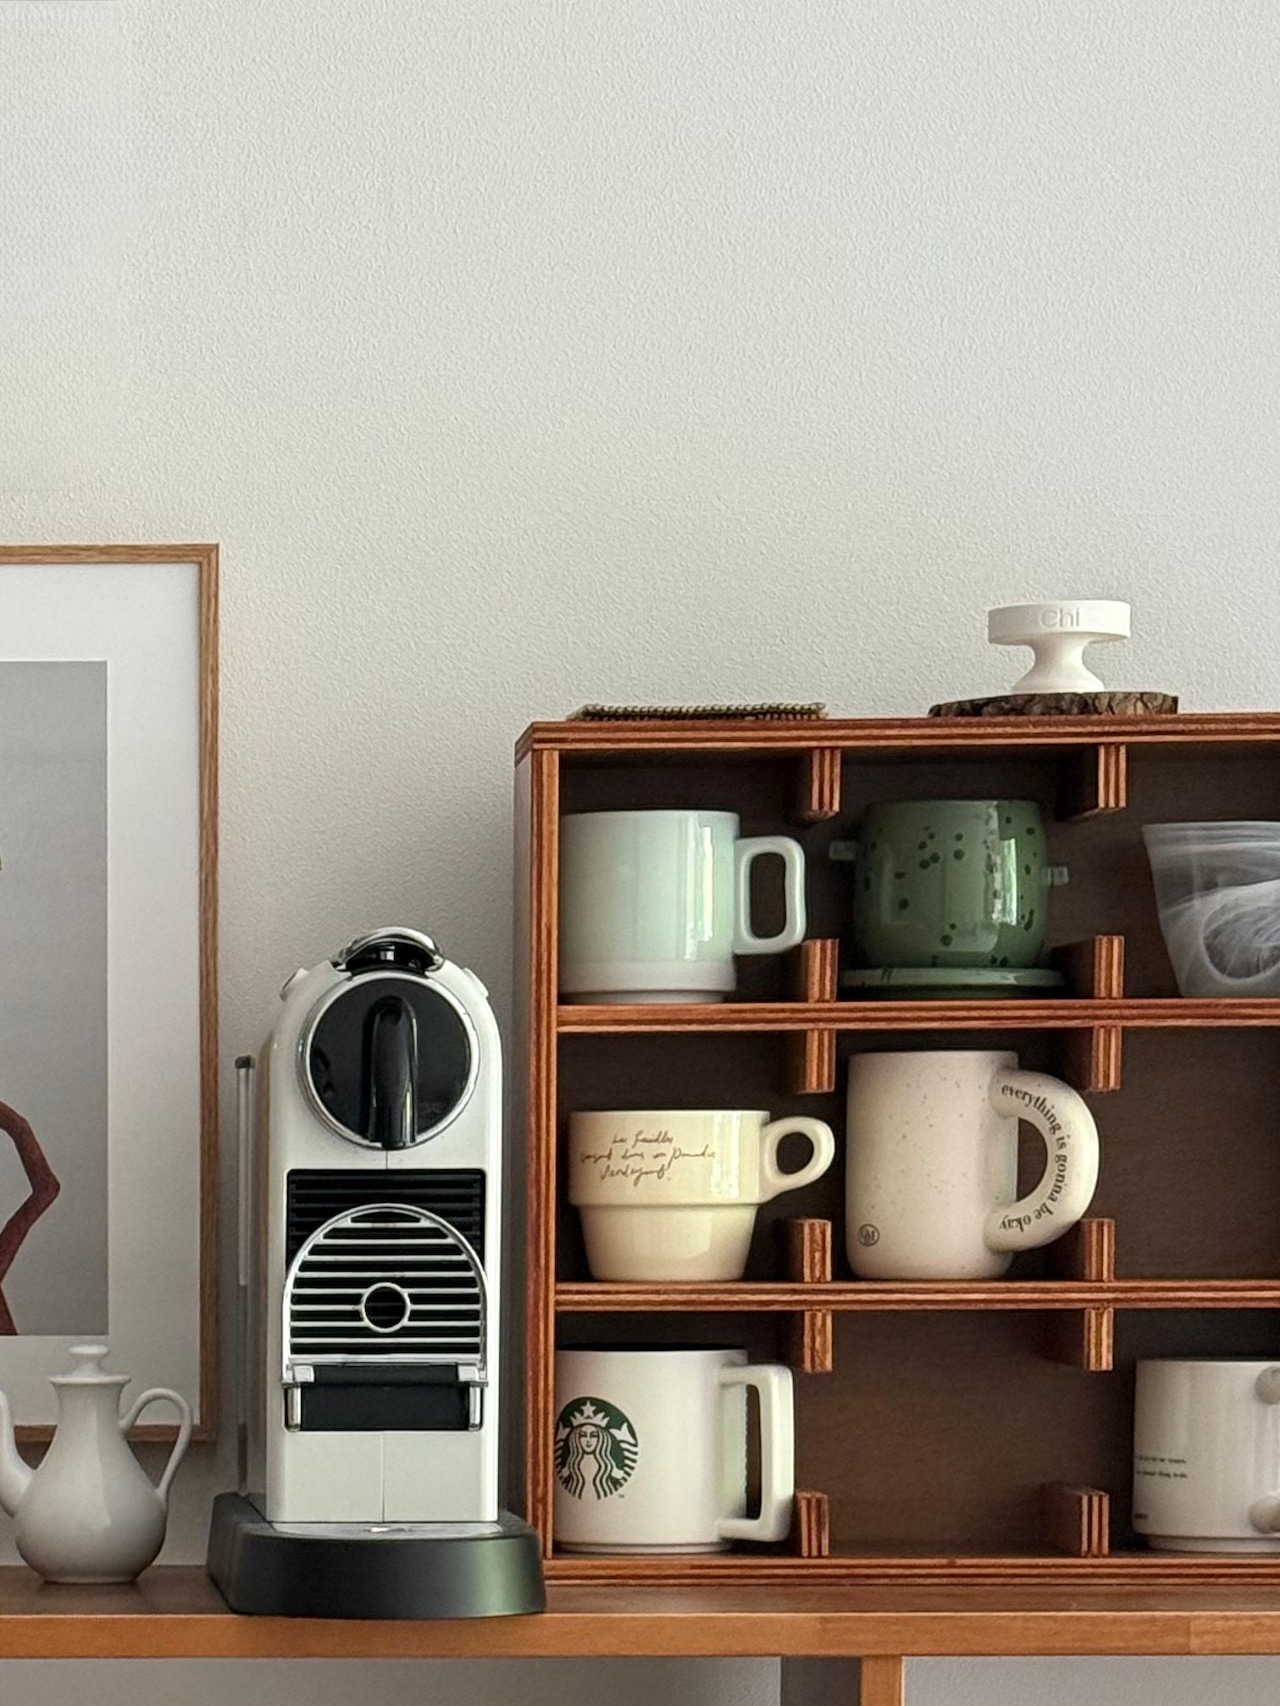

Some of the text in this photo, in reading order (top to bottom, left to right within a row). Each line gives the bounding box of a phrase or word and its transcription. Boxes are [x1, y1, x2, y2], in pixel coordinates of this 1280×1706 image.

[999, 1083, 1072, 1233] everything is gonna be okay
